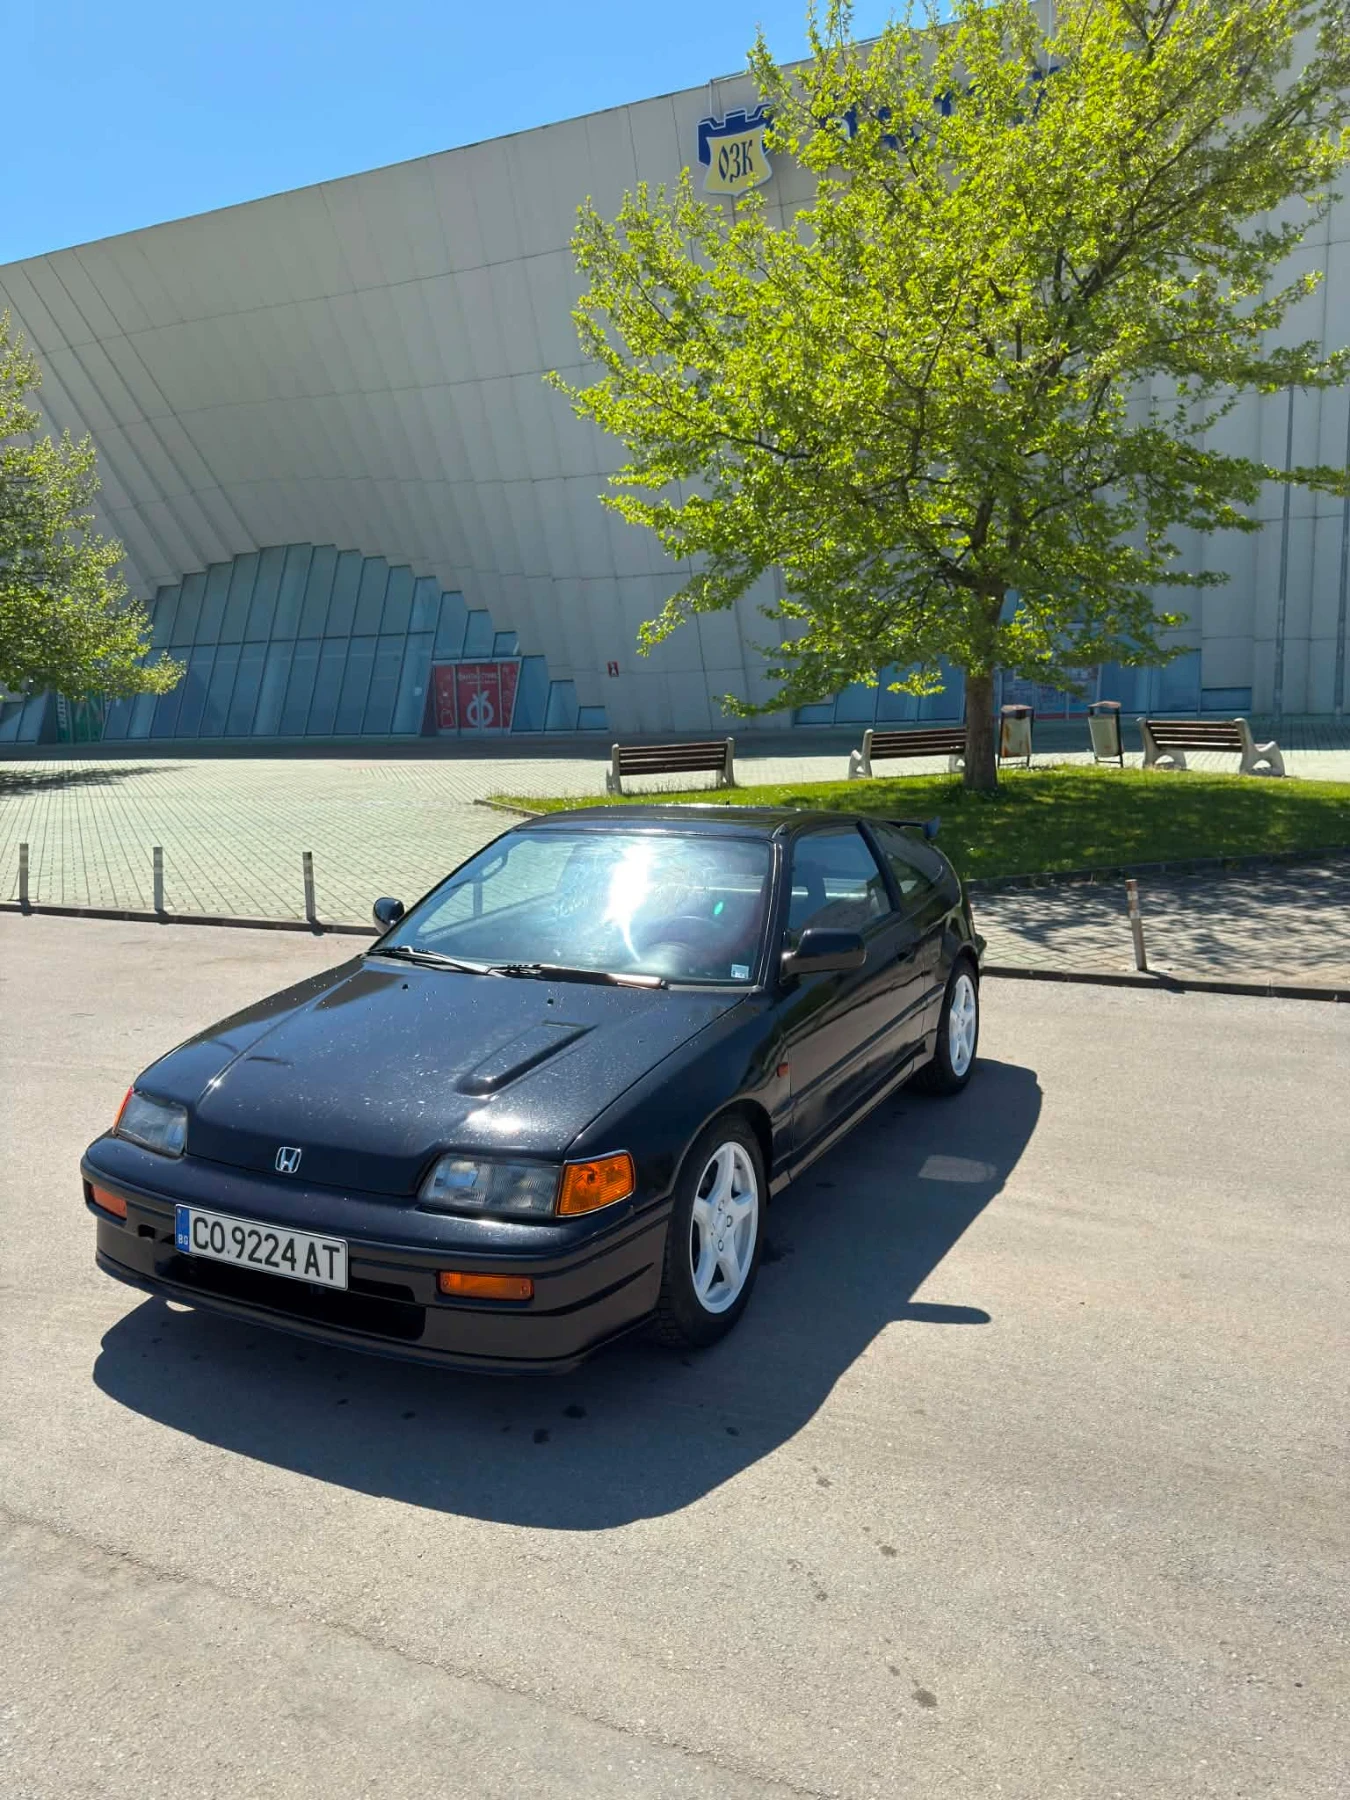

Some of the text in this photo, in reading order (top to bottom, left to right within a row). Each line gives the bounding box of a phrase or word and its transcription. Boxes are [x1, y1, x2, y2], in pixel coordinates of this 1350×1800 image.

[718, 139, 753, 183] ОЗК
[178, 1233, 189, 1246] BG
[231, 1226, 297, 1271] 9224
[304, 1242, 340, 1280] AT
